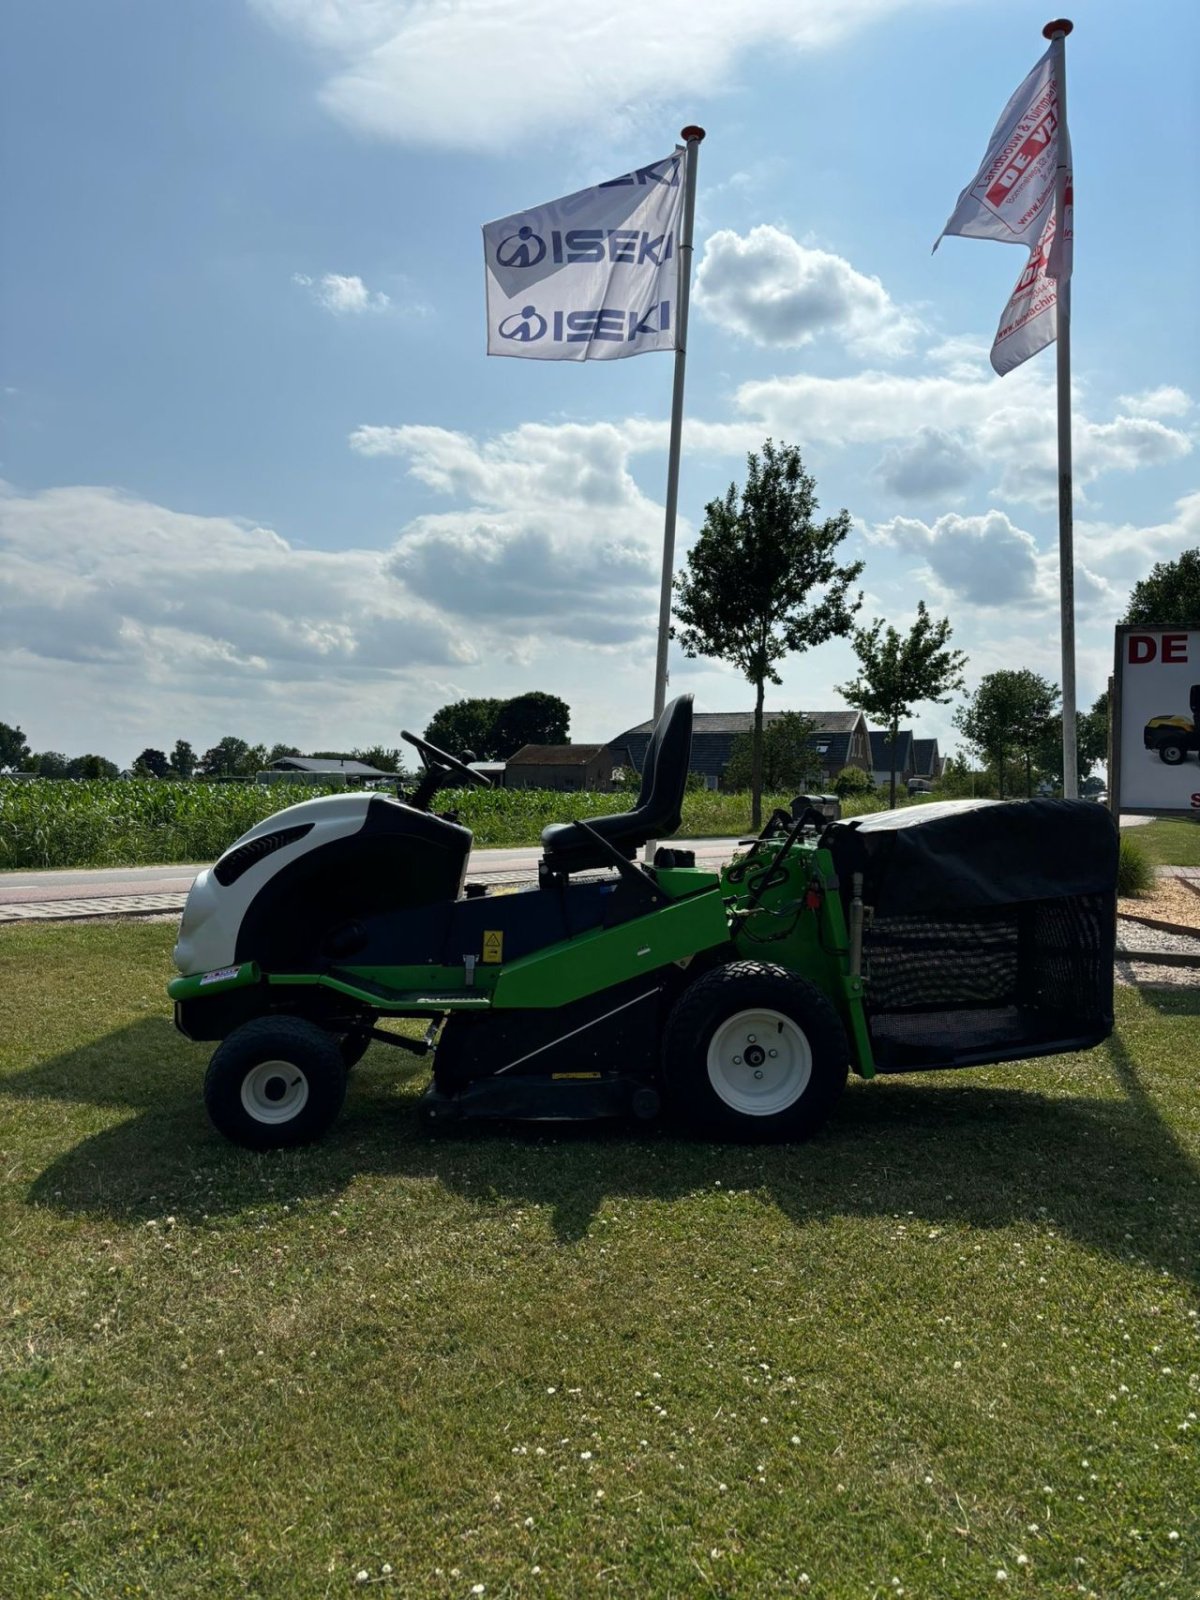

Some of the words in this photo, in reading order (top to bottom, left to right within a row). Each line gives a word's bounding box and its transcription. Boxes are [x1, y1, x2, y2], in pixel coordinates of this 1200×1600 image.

[977, 133, 1023, 188] Landbouw
[1018, 121, 1031, 134] &
[999, 152, 1032, 189] DE
[551, 229, 674, 266] ISEKI
[553, 301, 671, 342] ISEKI
[1128, 634, 1188, 664] DE
